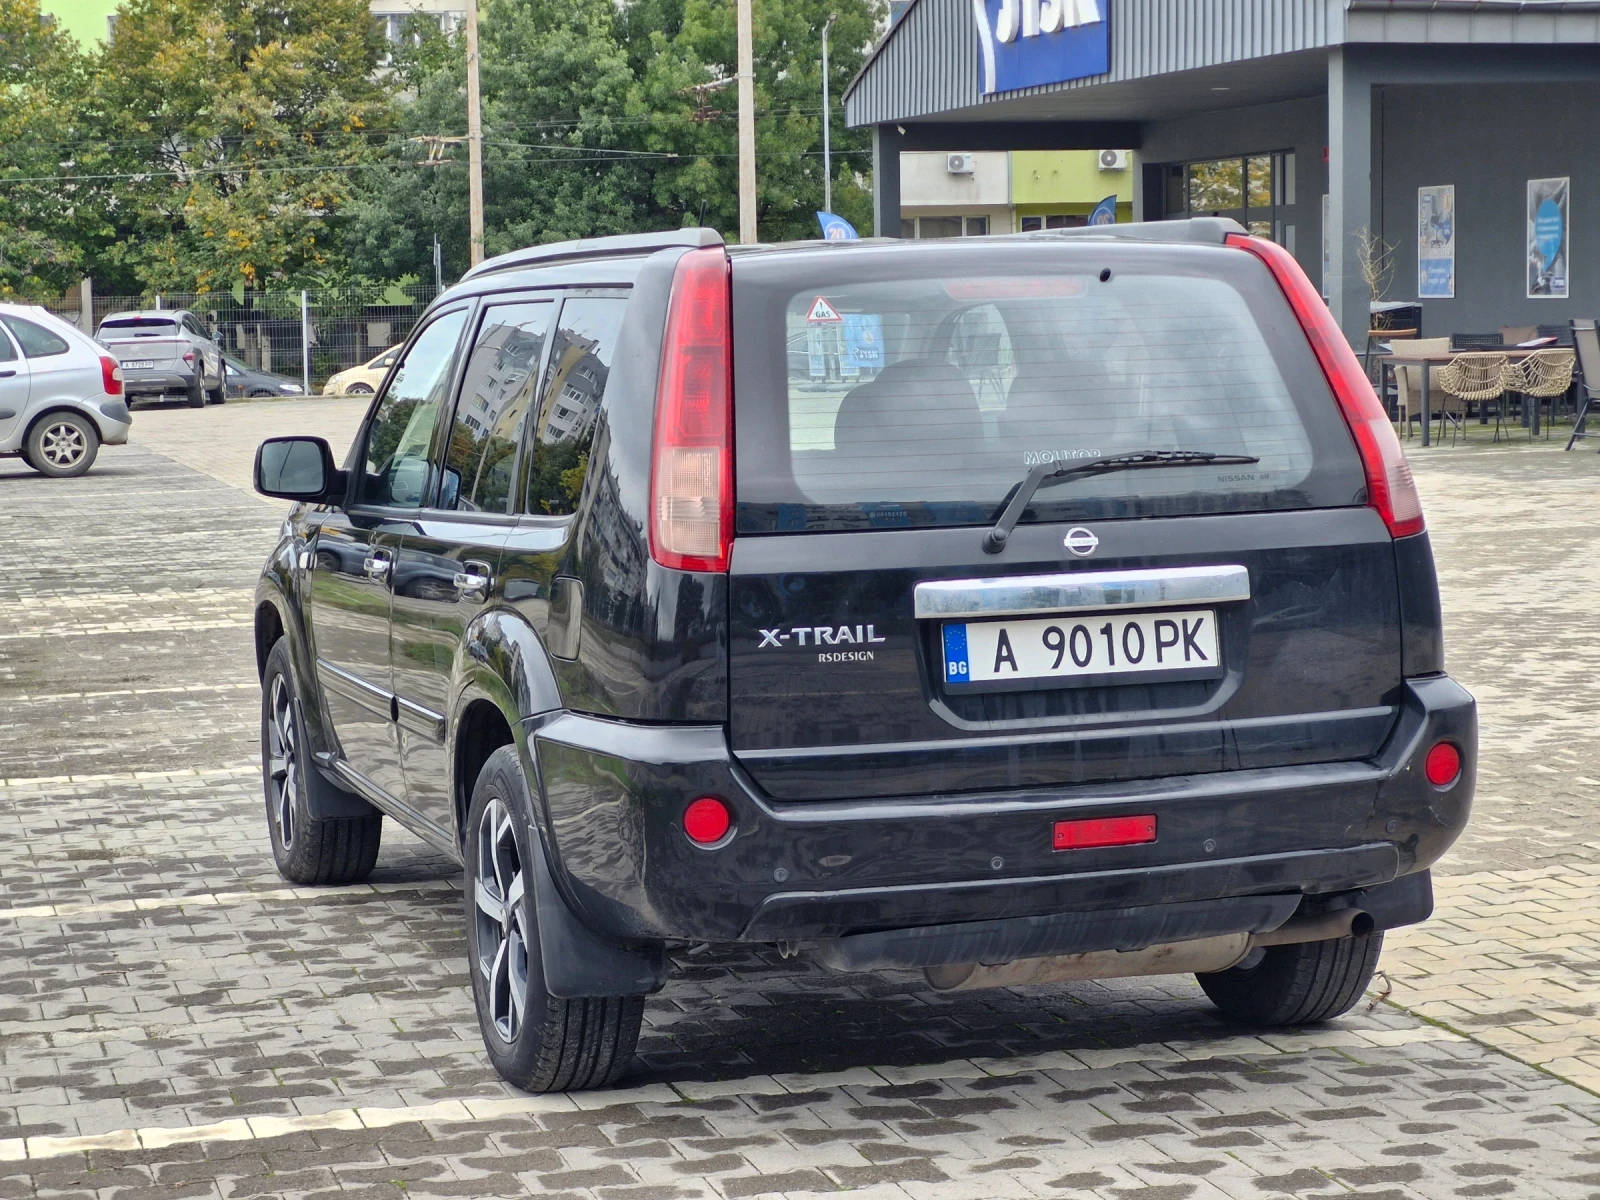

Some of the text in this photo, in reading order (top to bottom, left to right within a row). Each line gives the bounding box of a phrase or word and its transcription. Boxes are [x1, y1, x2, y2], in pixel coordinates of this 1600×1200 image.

[828, 228, 845, 240] 20
[815, 310, 831, 318] GAS
[1217, 474, 1254, 483] NISSAN
[758, 624, 886, 648] X-TRAIL
[818, 651, 874, 662] RSDESIGN
[949, 661, 967, 675] BG
[993, 628, 1019, 673] A
